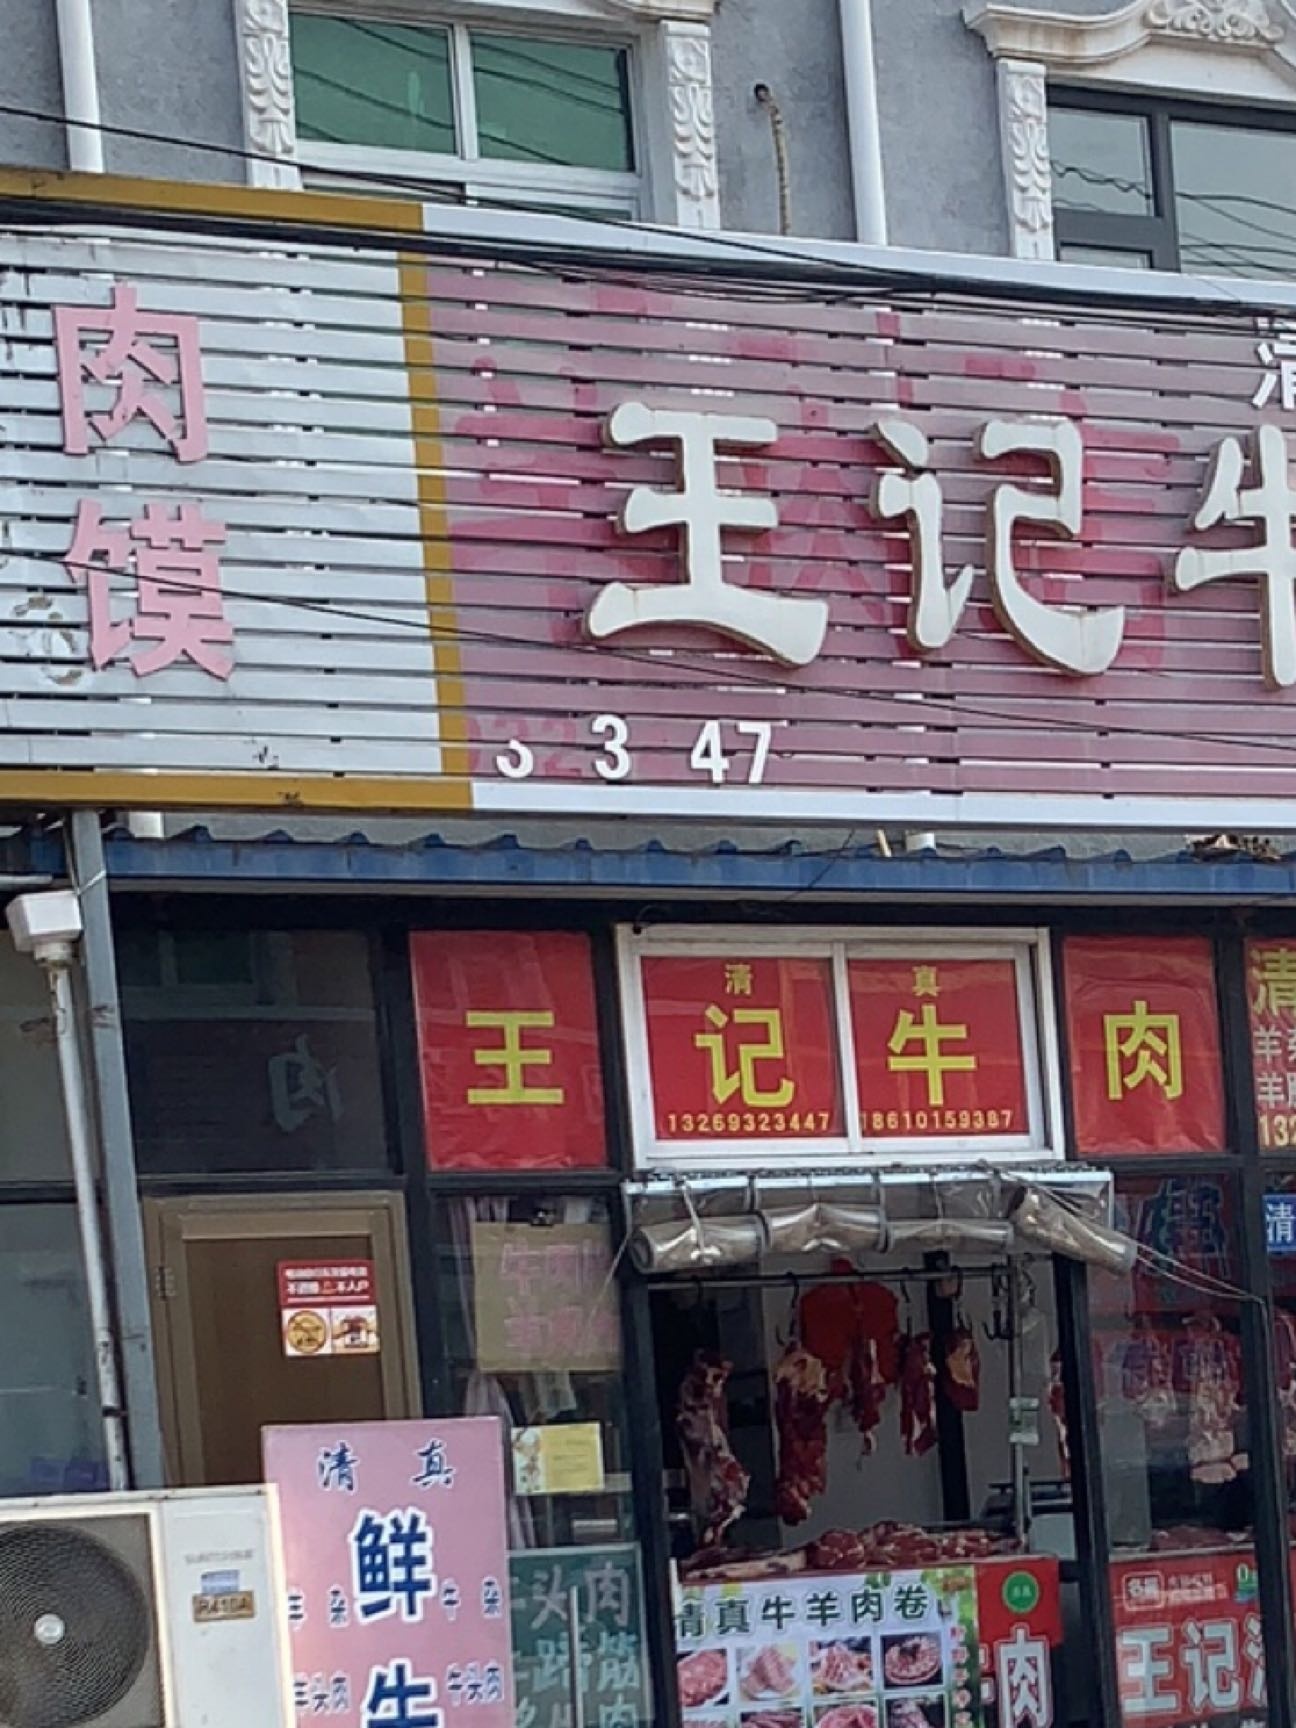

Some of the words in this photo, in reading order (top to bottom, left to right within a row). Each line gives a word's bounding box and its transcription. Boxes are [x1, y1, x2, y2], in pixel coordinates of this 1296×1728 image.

[53, 283, 235, 681] 肉馍
[591, 714, 631, 780] 3
[689, 720, 773, 785] 47
[724, 963, 754, 996] 清
[911, 965, 941, 998] 真
[464, 1009, 564, 1105] 王
[693, 1005, 795, 1108] 记
[887, 1003, 977, 1107] 牛
[1103, 1000, 1183, 1100] 肉
[667, 1113, 831, 1132] 13269323447
[317, 1440, 455, 1491] 清真
[677, 1585, 929, 1638] 清真牛羊肉卷
